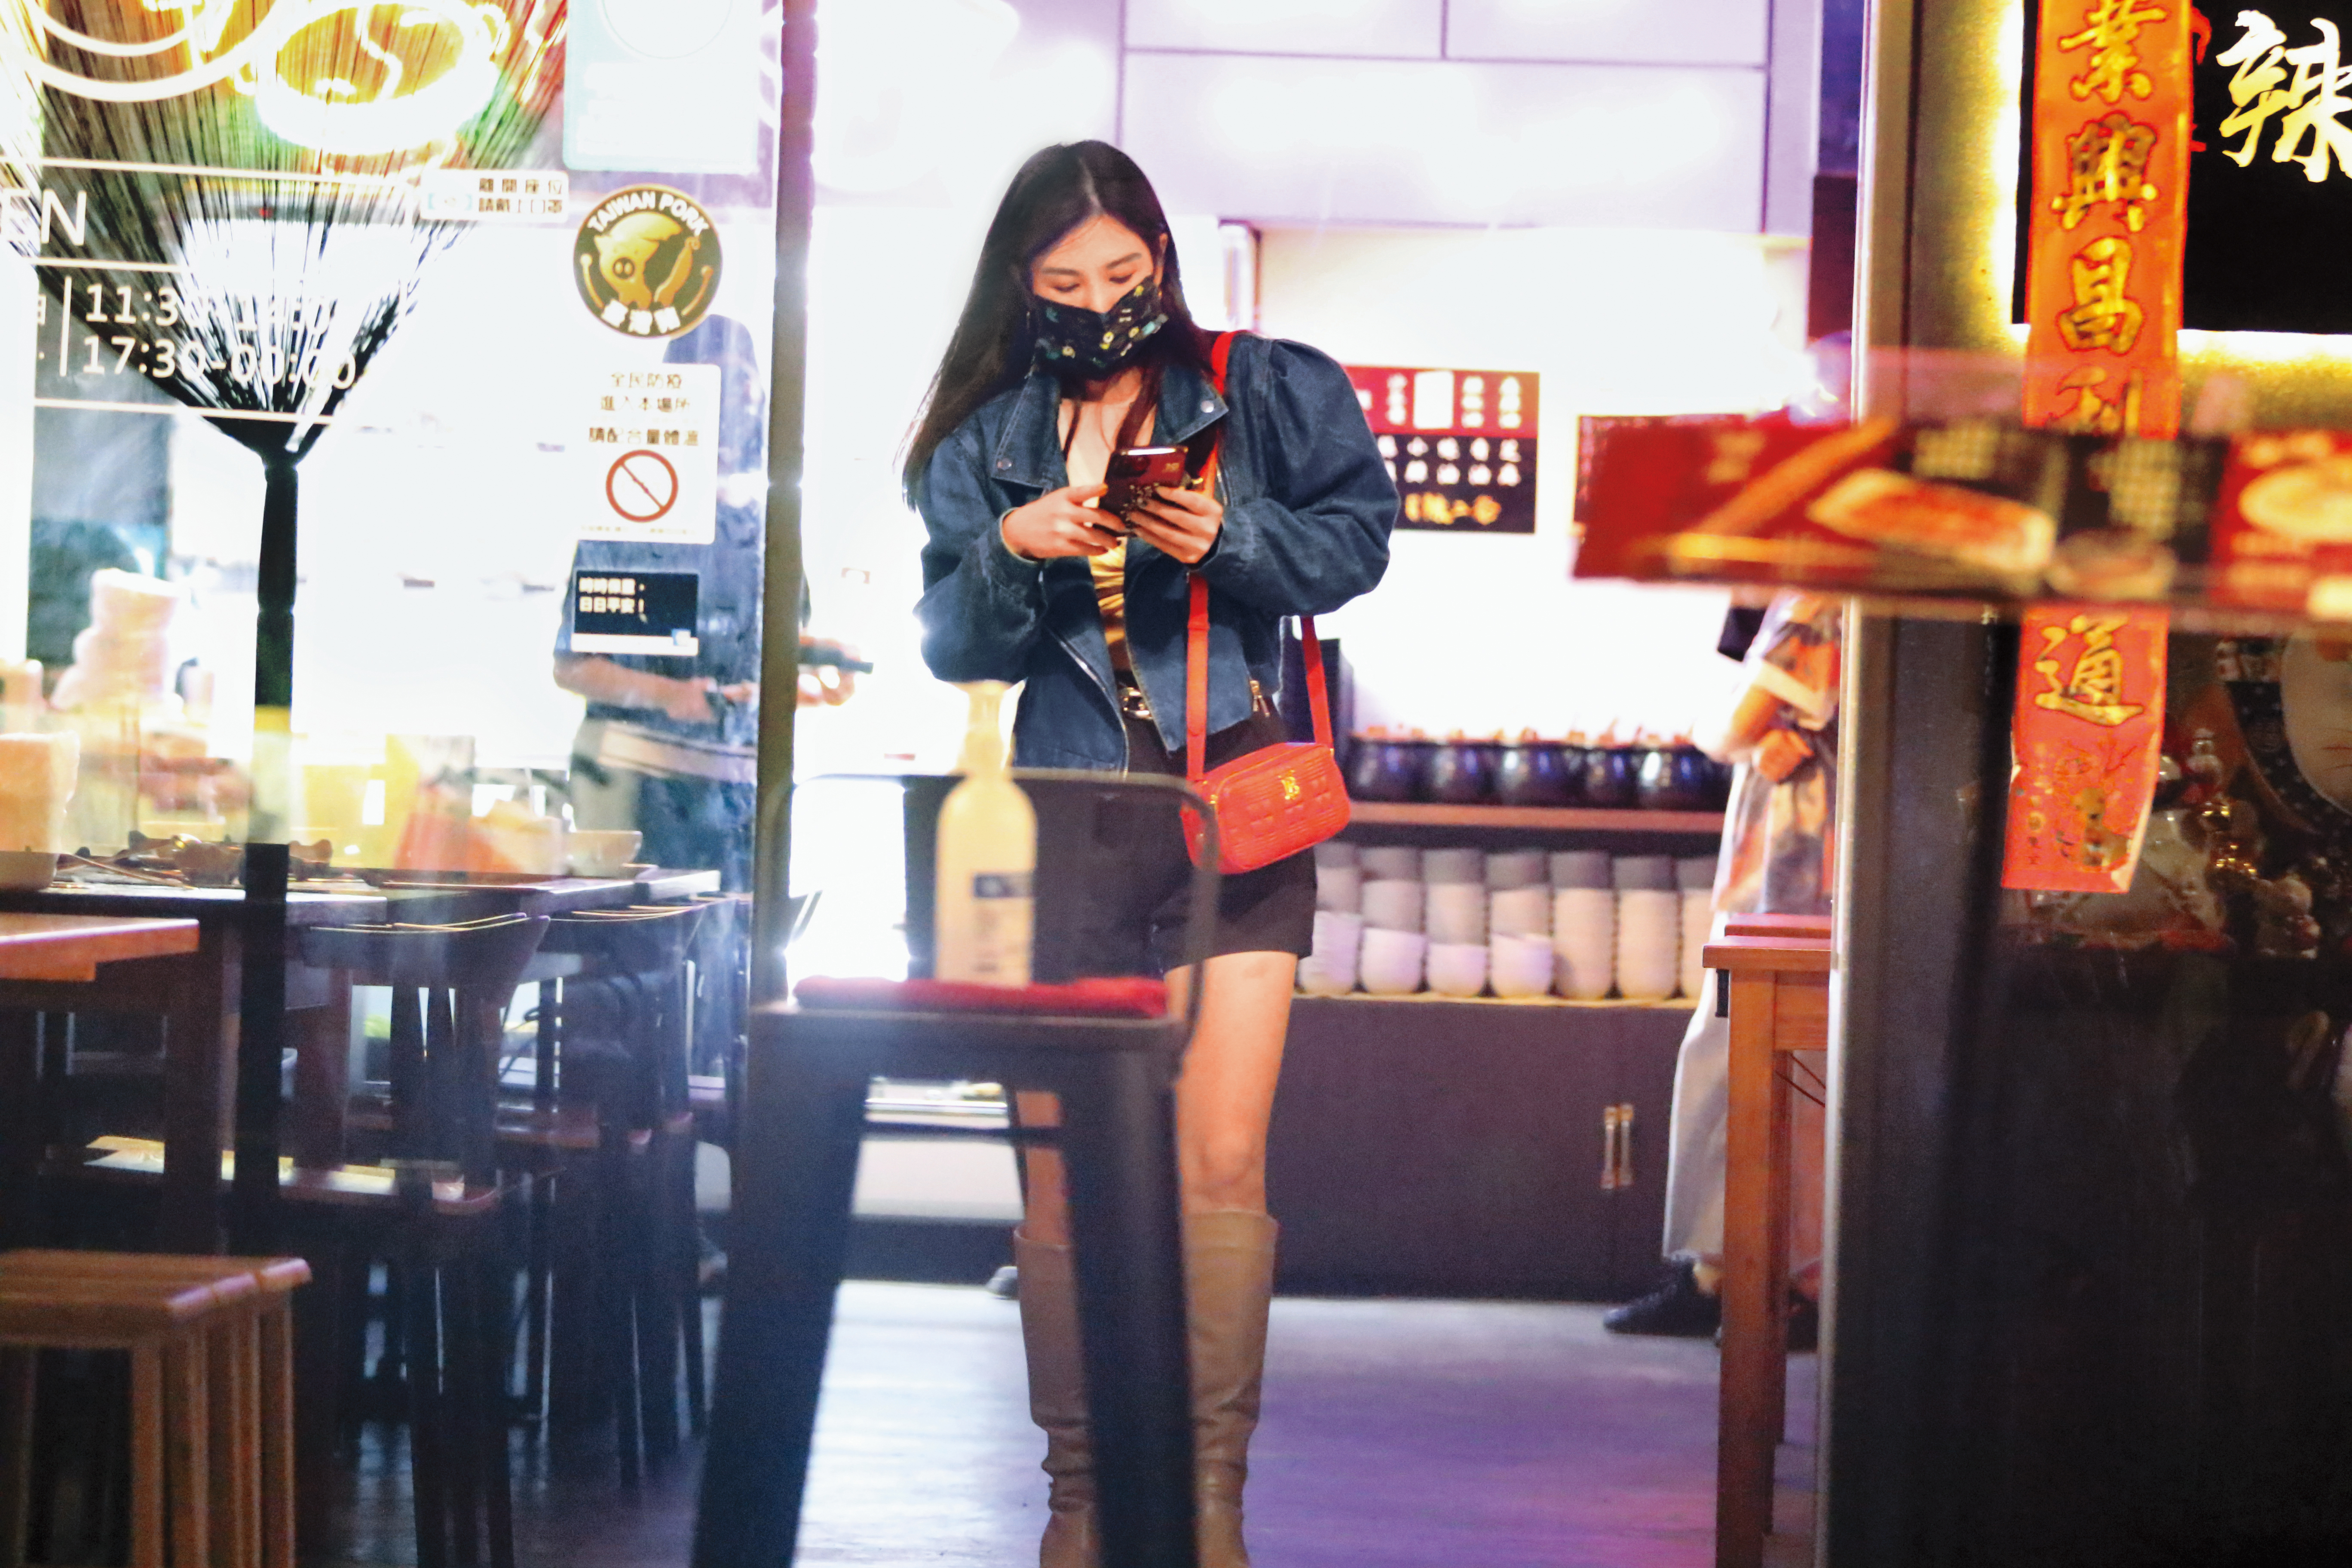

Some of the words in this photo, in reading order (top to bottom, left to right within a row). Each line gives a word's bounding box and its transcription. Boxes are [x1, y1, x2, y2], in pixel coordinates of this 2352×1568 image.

[2216, 10, 2352, 182] 辣
[588, 192, 656, 232] TAIWAN
[659, 193, 710, 236] PORK
[611, 371, 683, 389] 全民防疫
[600, 395, 690, 413] 進入本場所
